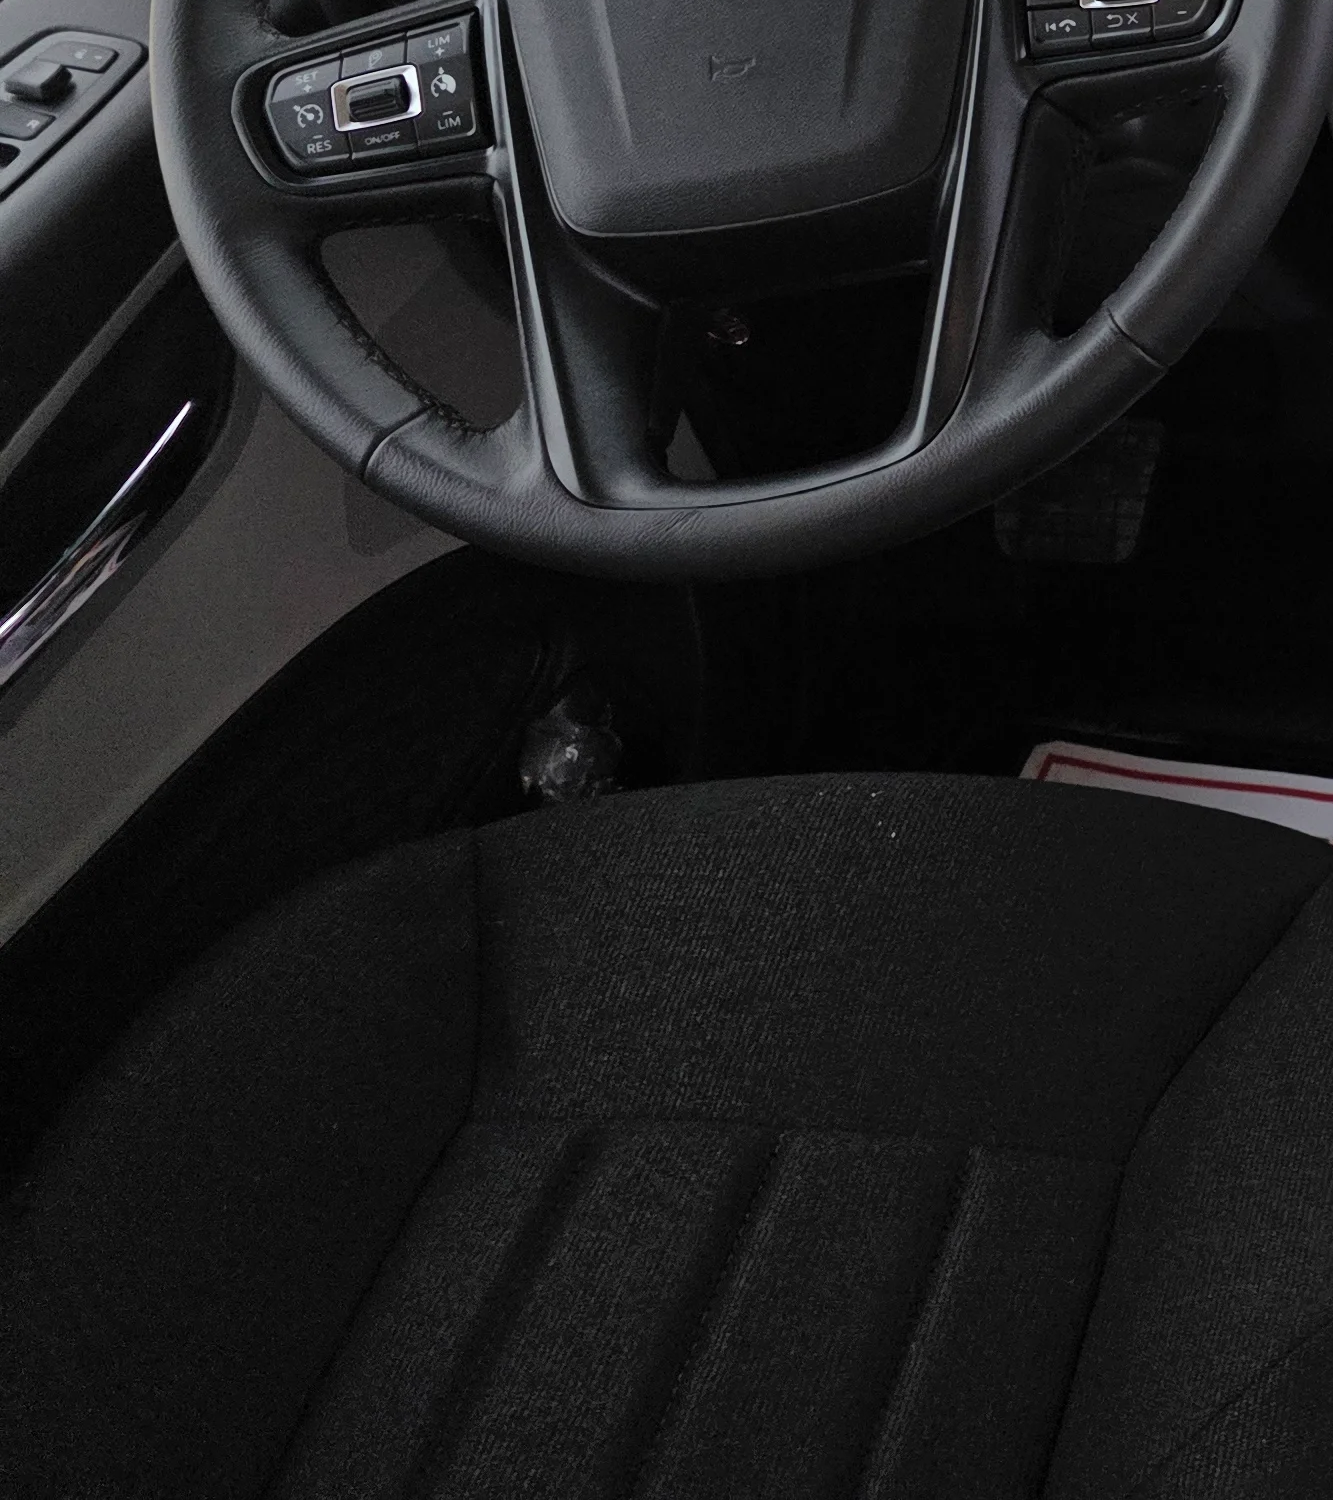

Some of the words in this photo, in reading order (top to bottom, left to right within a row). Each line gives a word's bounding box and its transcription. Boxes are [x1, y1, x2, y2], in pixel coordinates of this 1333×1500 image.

[427, 34, 451, 49] LIM
[295, 69, 320, 84] SET
[437, 116, 462, 131] LIM
[364, 130, 401, 146] ON/OFF
[306, 140, 333, 155] RES
